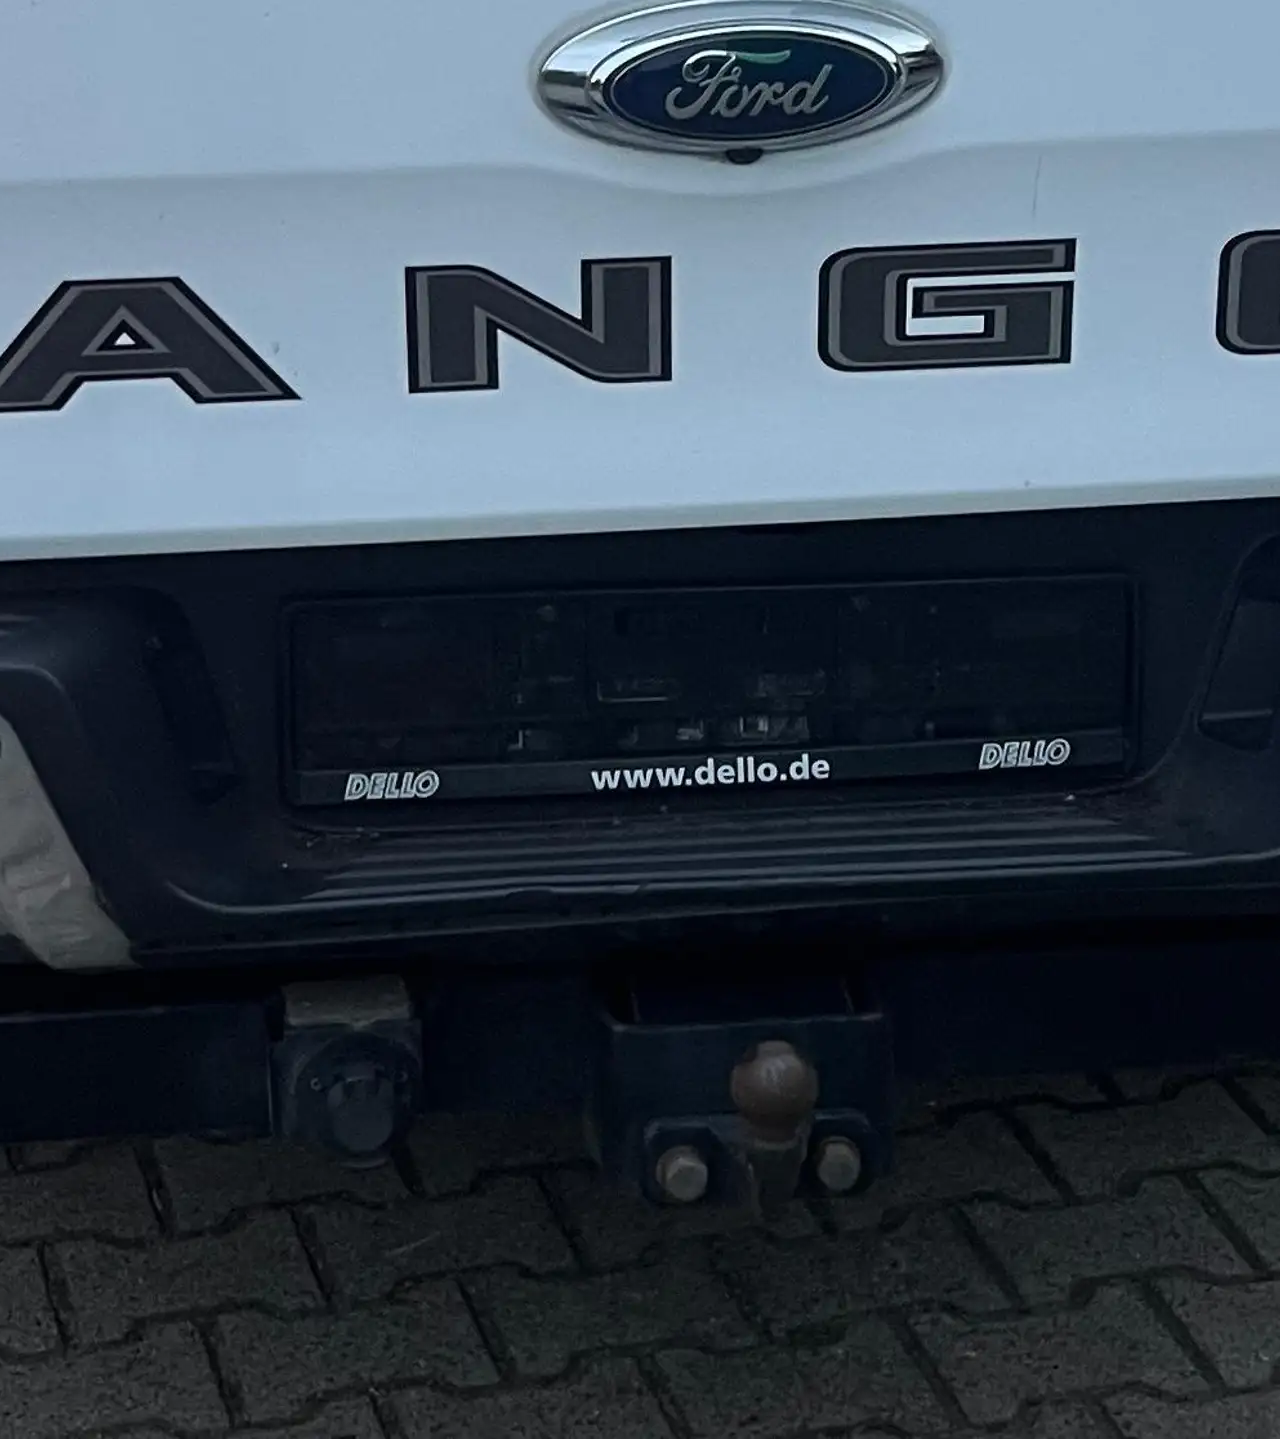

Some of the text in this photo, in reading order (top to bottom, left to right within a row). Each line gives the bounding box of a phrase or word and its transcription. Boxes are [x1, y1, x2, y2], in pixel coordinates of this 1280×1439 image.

[663, 49, 832, 121] Ford
[344, 738, 1071, 801] DELLO www.dello.de DELLO
